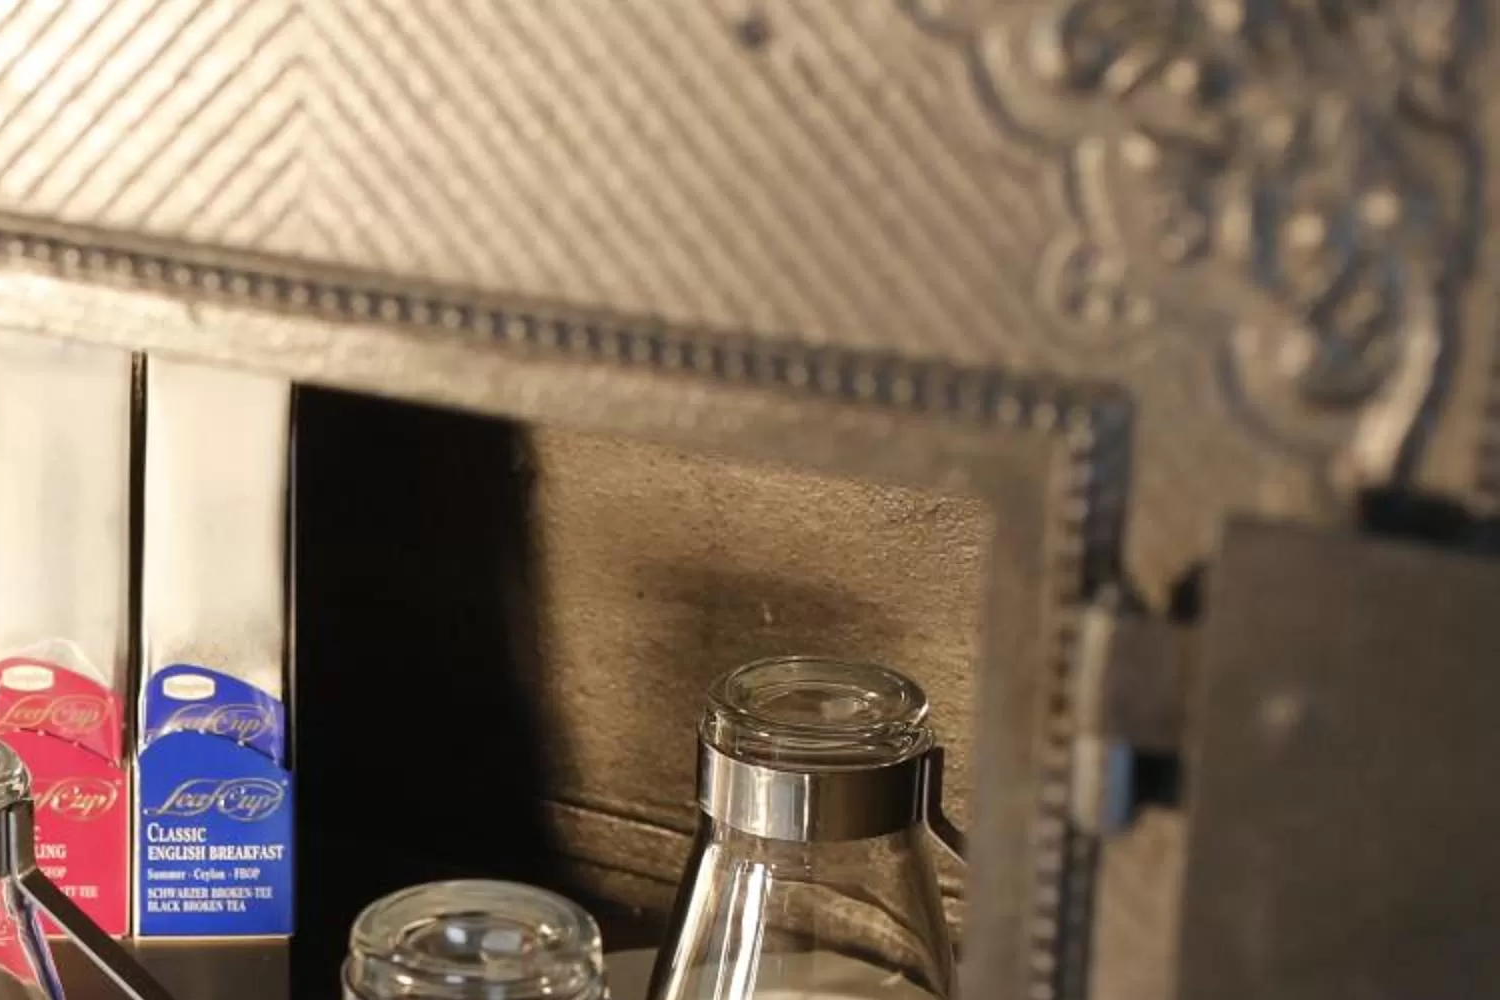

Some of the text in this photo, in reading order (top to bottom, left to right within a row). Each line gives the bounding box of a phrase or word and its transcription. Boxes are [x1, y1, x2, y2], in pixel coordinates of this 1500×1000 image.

[147, 822, 207, 842] CLASSIC
[147, 845, 285, 861] ENGLISH BREAKFAST
[226, 900, 247, 912] TEA
